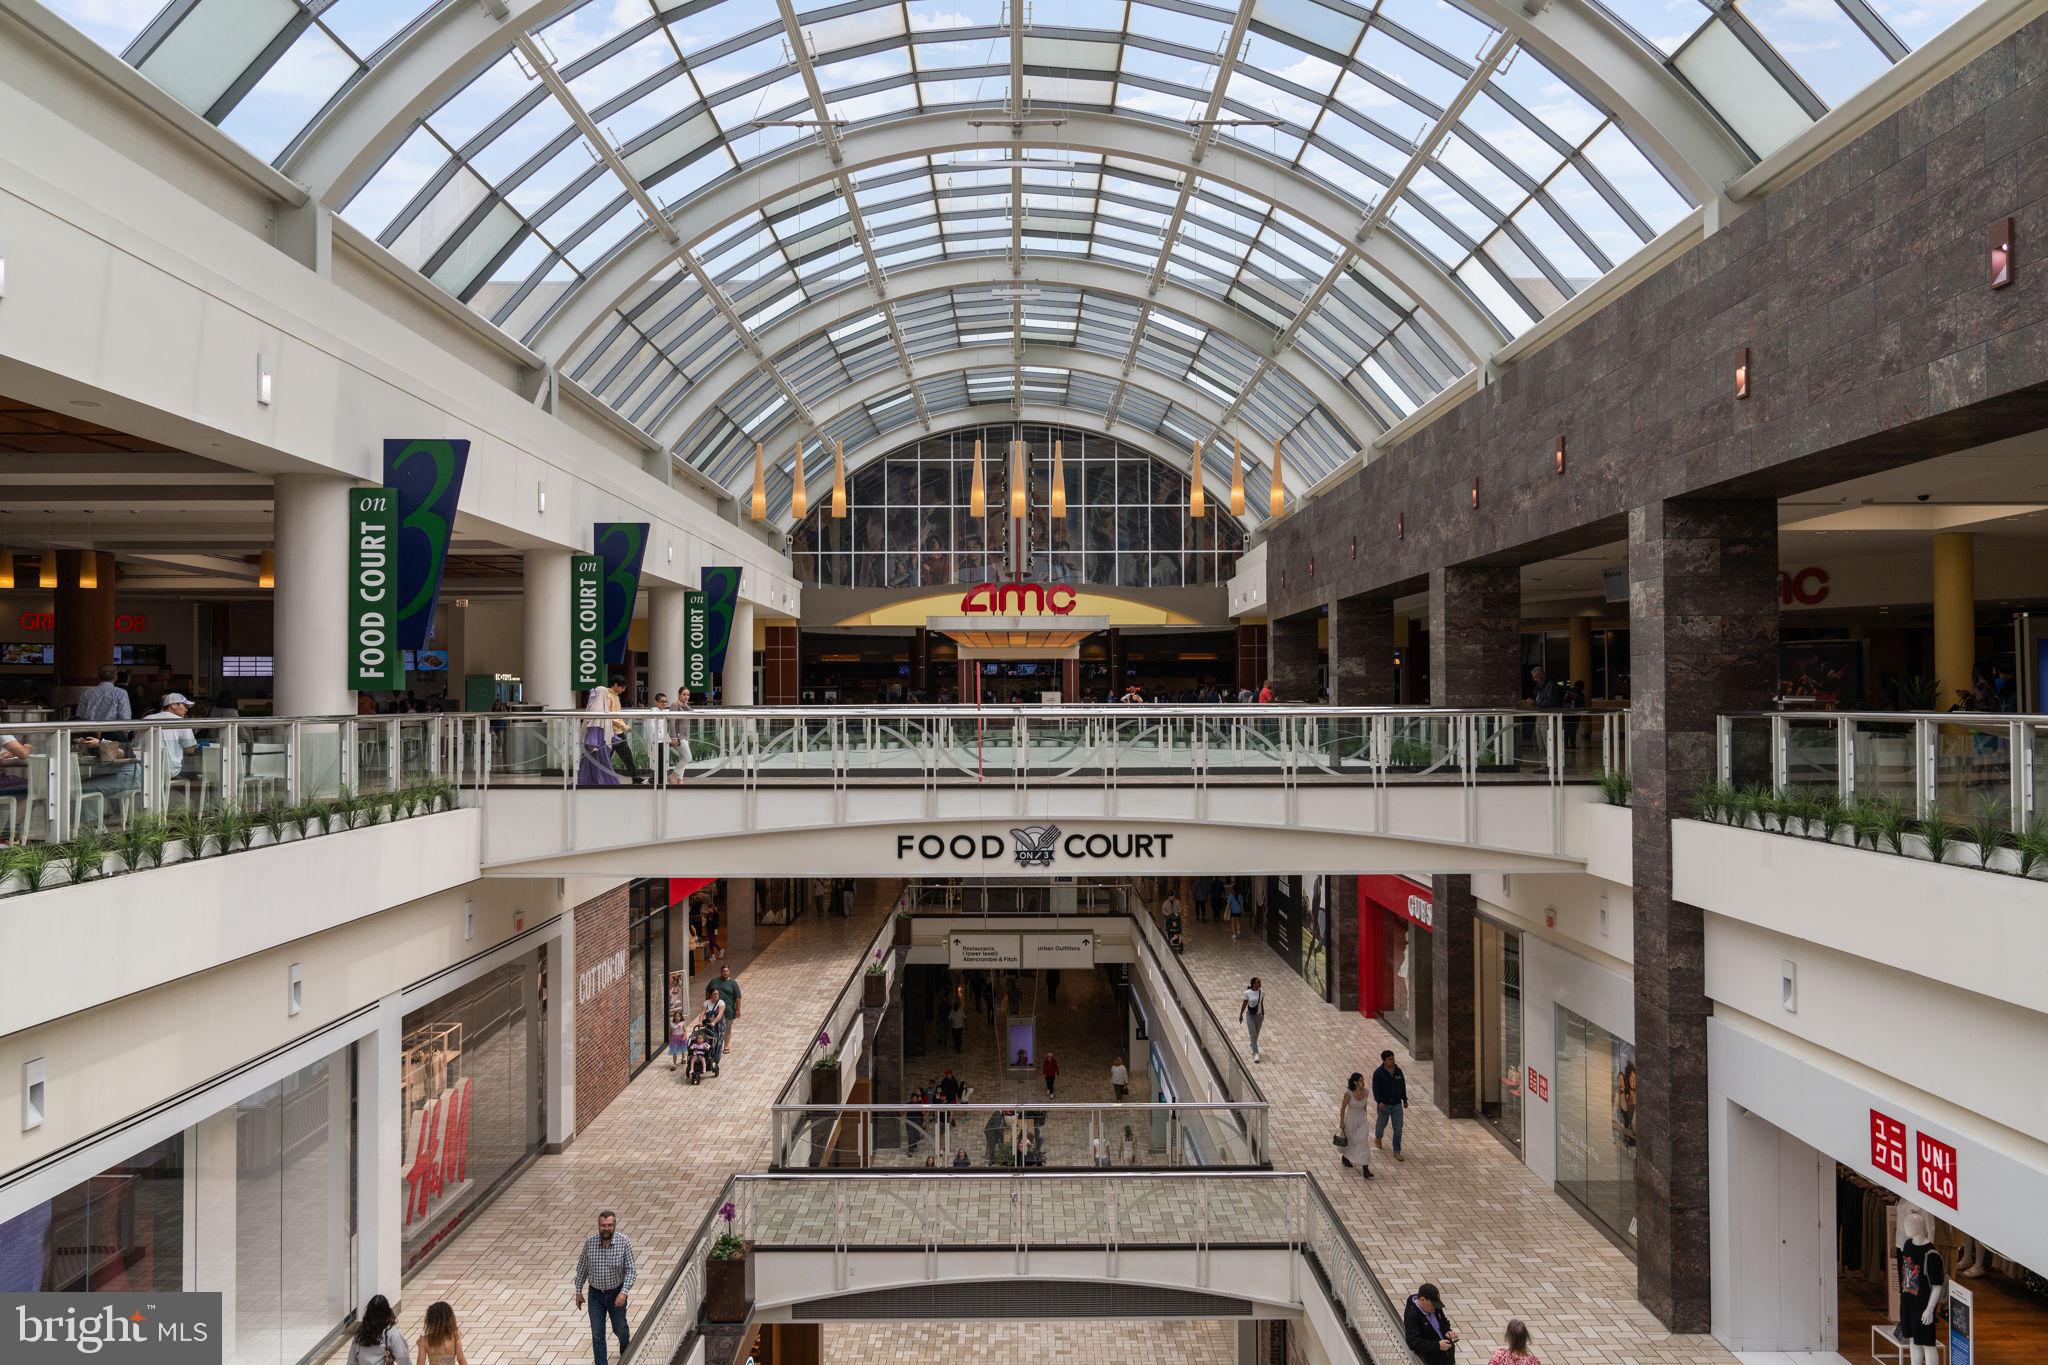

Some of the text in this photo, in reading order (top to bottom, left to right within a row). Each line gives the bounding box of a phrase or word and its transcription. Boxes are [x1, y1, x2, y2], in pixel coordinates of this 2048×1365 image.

[360, 497, 387, 512] on
[392, 440, 456, 622] 3
[579, 562, 597, 572] on
[600, 523, 641, 645] 3
[359, 521, 386, 678] FOOD COURT
[690, 596, 704, 604] on
[706, 567, 737, 658] 3
[579, 578, 597, 683] FOOD COURT
[690, 608, 704, 687] FOOD COURT
[897, 833, 1174, 859] FOOD COURT
[1019, 851, 1049, 860] ON 3
[1408, 895, 1433, 926] GUES
[406, 1077, 473, 1227] H&M
[1921, 1140, 1950, 1174] UNI
[1922, 1166, 1954, 1199] QLO
